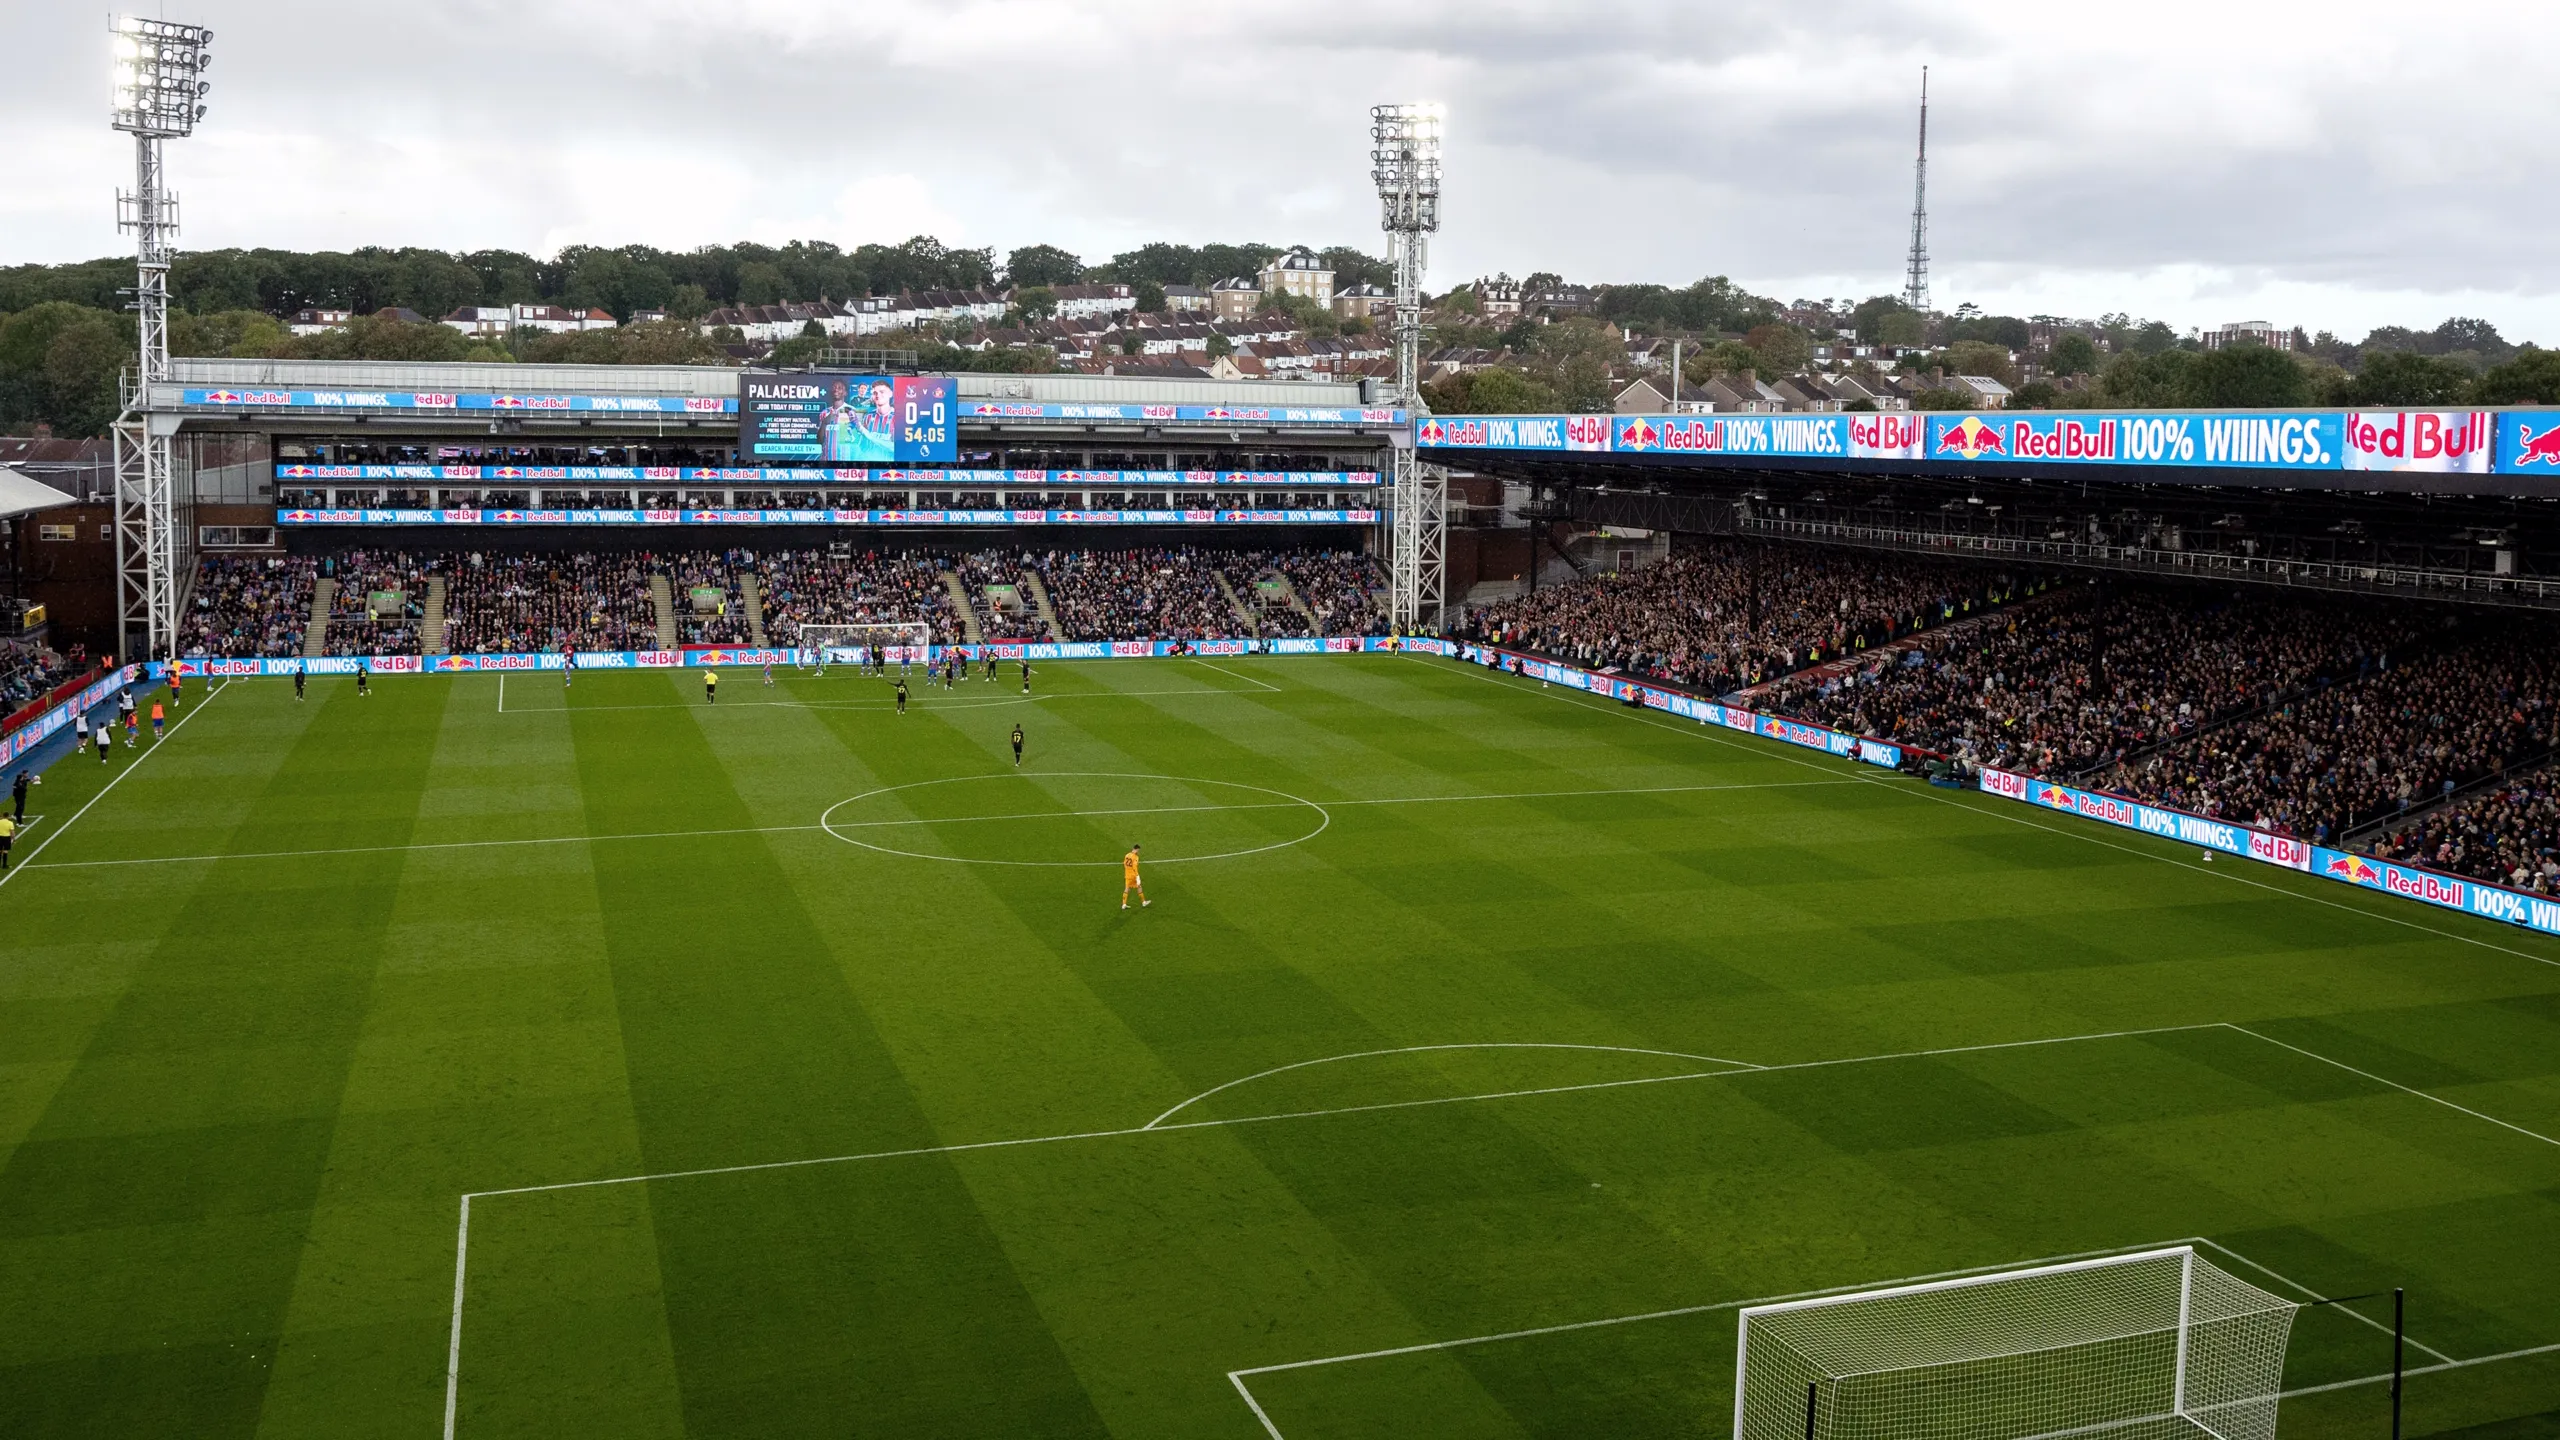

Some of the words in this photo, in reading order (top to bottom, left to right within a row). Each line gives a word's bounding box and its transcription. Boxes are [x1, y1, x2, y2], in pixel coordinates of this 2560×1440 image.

[749, 385, 796, 398] PALACE
[905, 402, 945, 425] 0-0
[905, 428, 945, 443] 54:05
[1449, 422, 1468, 444] Red
[1469, 422, 1487, 444] Bull
[1489, 421, 1514, 446] 100%
[1518, 421, 1561, 447] WIIINGS.
[1588, 417, 1610, 444] Bull
[1664, 420, 1692, 449] Red
[1694, 420, 1722, 449] Bull
[1727, 420, 1767, 451] 100%
[1772, 420, 1841, 452] WIIINGS.
[1884, 416, 1920, 448] Bull
[2015, 422, 2060, 456] Red
[2066, 422, 2114, 456] Bull
[2122, 419, 2194, 460] 100%
[2203, 418, 2330, 462] WIIINGS.
[2414, 412, 2484, 458] Bull
[739, 652, 762, 664] Red
[1029, 647, 1050, 658] 100%
[1055, 644, 1104, 657] WIIINGS.
[1201, 643, 1220, 654] Red
[1221, 642, 1242, 654] Bull
[267, 660, 301, 673] 100%
[482, 653, 508, 668] Red
[510, 652, 533, 668] Bull
[578, 652, 627, 666] WIIINGS.
[1672, 696, 1689, 714] 100%
[1791, 727, 1808, 743] Red
[1809, 732, 1826, 748] Bull
[2080, 796, 2104, 817] Red
[2107, 802, 2132, 824] Bull
[2140, 808, 2176, 835] 100%
[2179, 818, 2238, 851] WIIINGS.
[2277, 837, 2306, 863] Bull
[2388, 870, 2422, 900] Red
[2426, 877, 2463, 906] Bull
[2472, 886, 2525, 920] 100%
